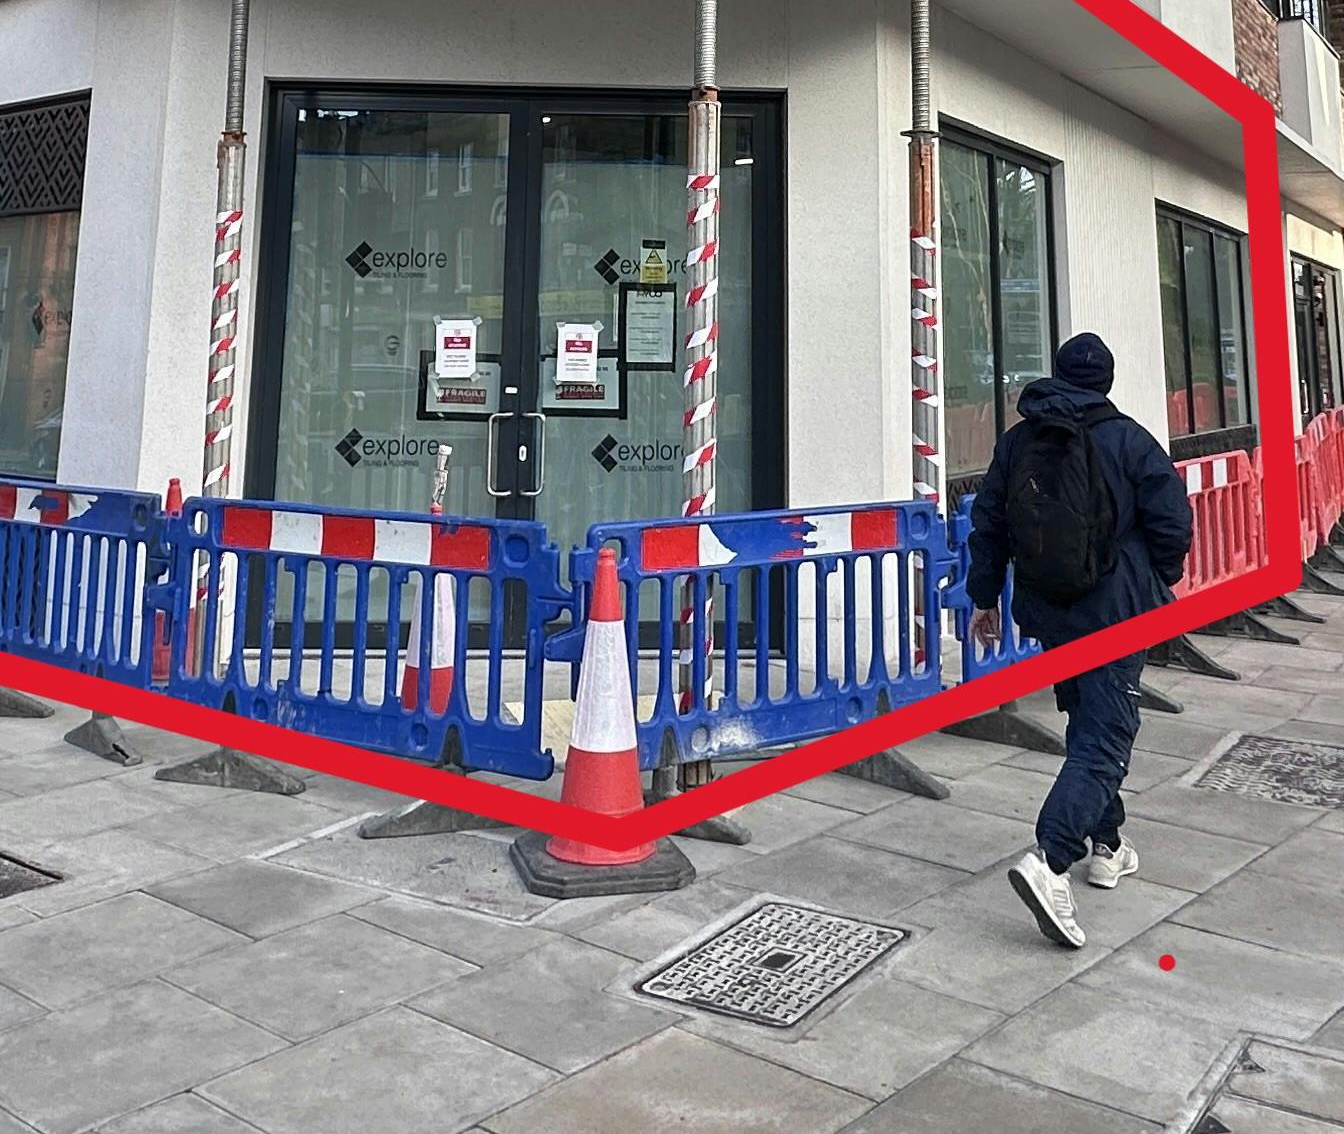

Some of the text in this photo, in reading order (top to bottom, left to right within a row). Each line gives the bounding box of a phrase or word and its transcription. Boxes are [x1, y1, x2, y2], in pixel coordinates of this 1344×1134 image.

[372, 247, 448, 273] explore
[445, 389, 486, 398] FRAGILE
[564, 385, 603, 393] FRAGILE
[362, 434, 439, 460] explore
[618, 439, 684, 465] explor
